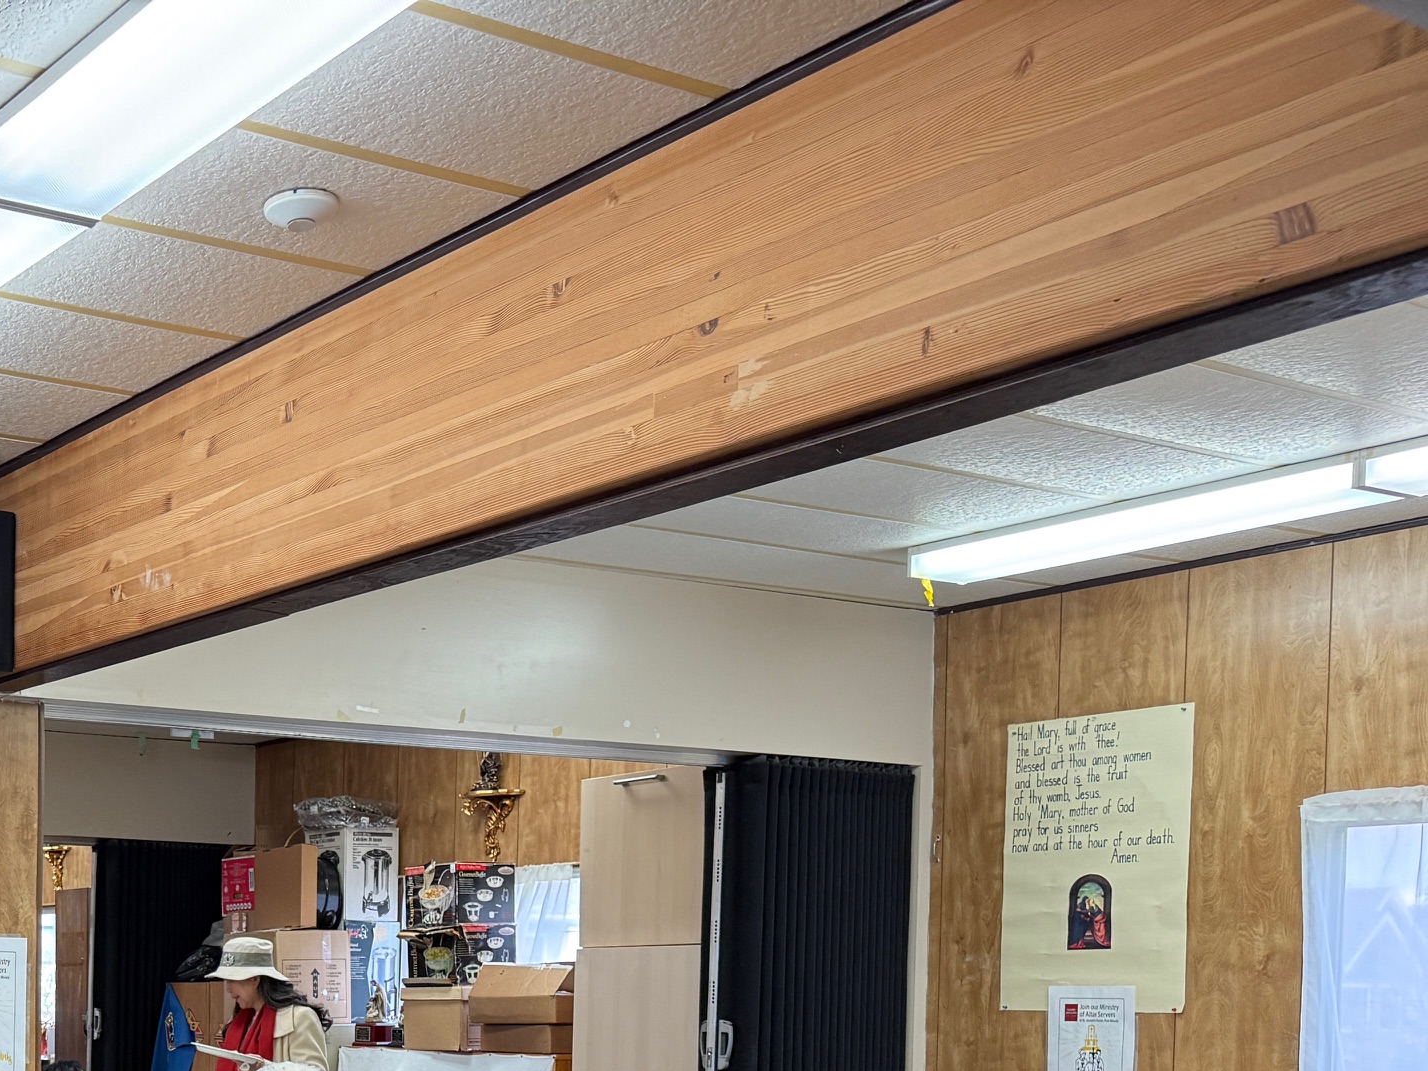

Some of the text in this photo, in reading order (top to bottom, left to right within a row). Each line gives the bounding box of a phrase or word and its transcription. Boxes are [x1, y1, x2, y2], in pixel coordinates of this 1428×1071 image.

[1017, 724, 1033, 741] Hail
[1065, 720, 1077, 736] full
[1082, 718, 1090, 734] of
[1094, 722, 1116, 738] grace
[1016, 742, 1029, 757] the
[1033, 739, 1051, 756] Lord
[1057, 738, 1064, 753] is
[1069, 736, 1086, 751] with
[1015, 751, 1152, 774] Blessed art thou among women
[1014, 764, 1128, 789] and blessed is the fruit
[1014, 785, 1102, 809] of thy womb, Jesus.
[1012, 806, 1032, 827] Holy
[1069, 801, 1098, 817] mother
[1102, 799, 1111, 814] of
[1117, 797, 1135, 813] God
[1011, 828, 1175, 853] now and at the hour of our death.
[1012, 819, 1099, 844] pray for us sinners
[1110, 848, 1139, 864] Amen.
